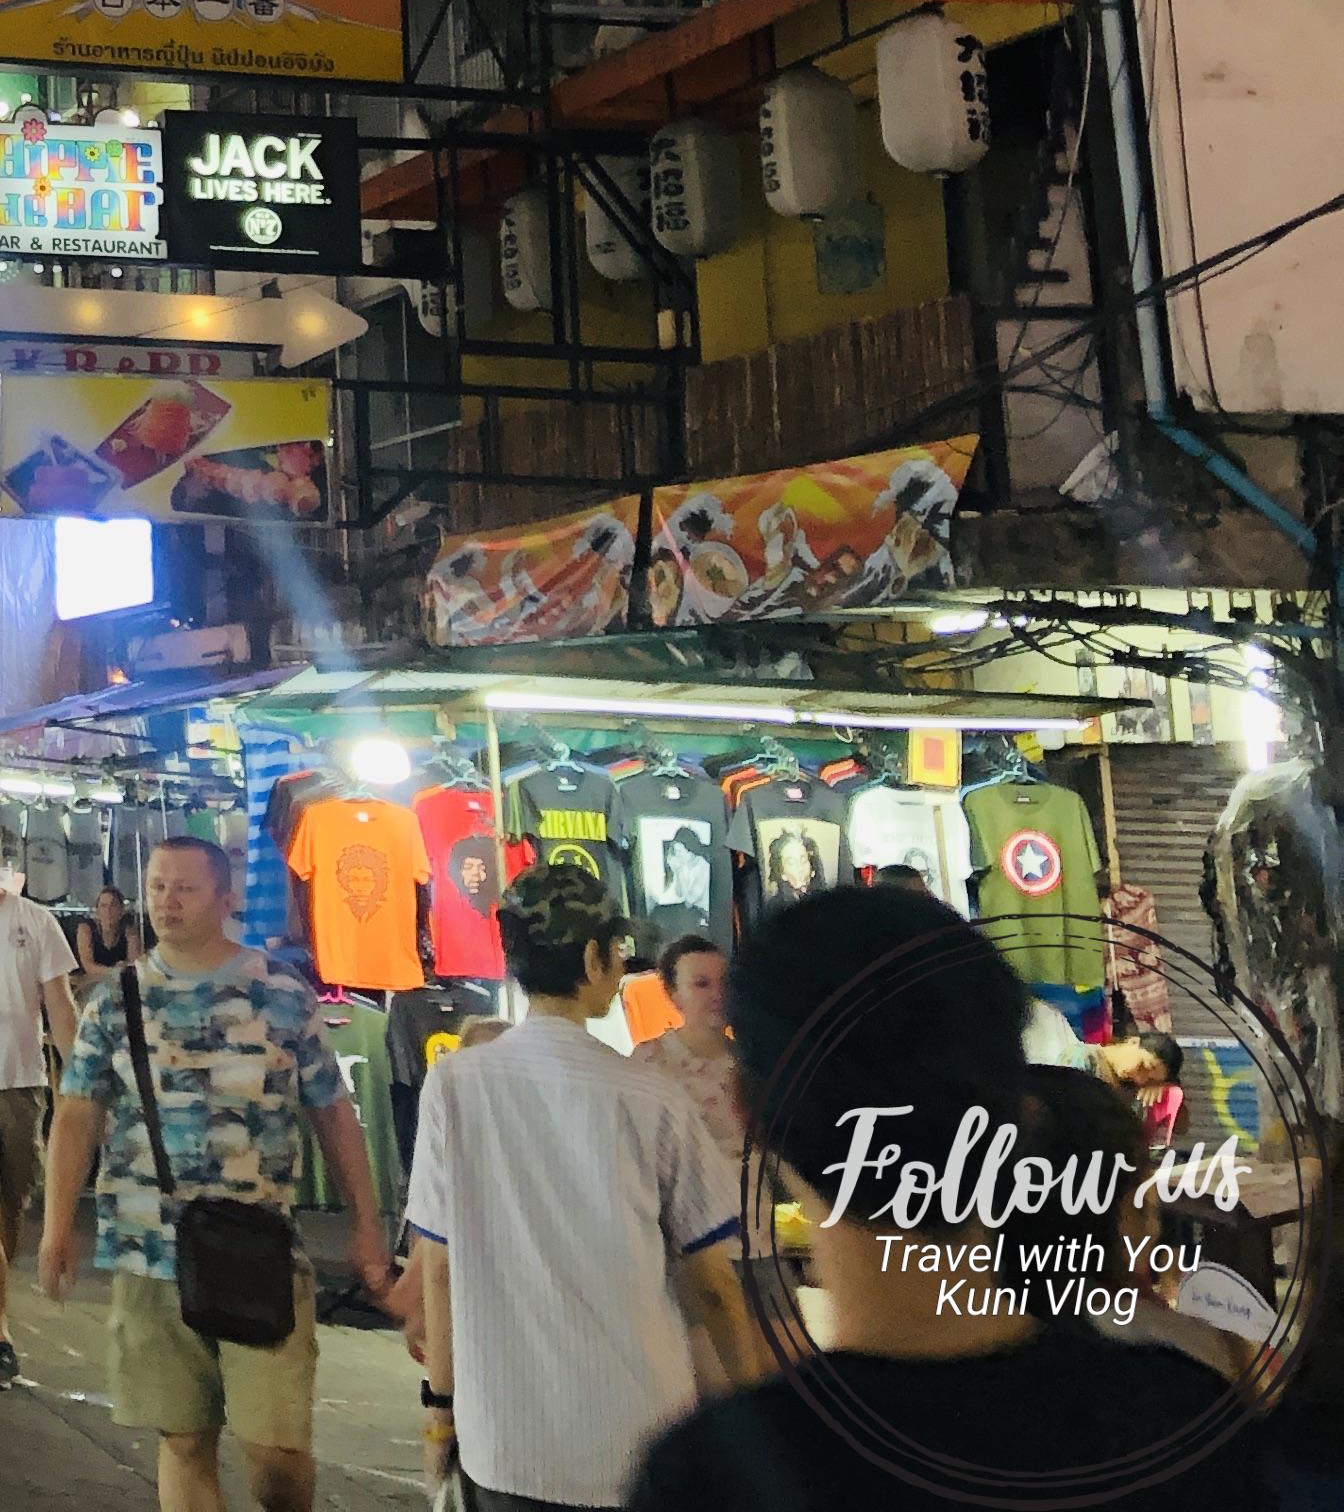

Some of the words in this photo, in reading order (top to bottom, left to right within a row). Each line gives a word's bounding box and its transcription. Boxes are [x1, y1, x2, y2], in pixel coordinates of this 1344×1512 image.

[191, 133, 325, 181] JACK
[192, 178, 259, 203] LIVES
[263, 180, 333, 205] HERE.
[30, 237, 44, 252] &
[52, 238, 163, 257] RESTAURANT
[539, 809, 608, 842] NIRVANA
